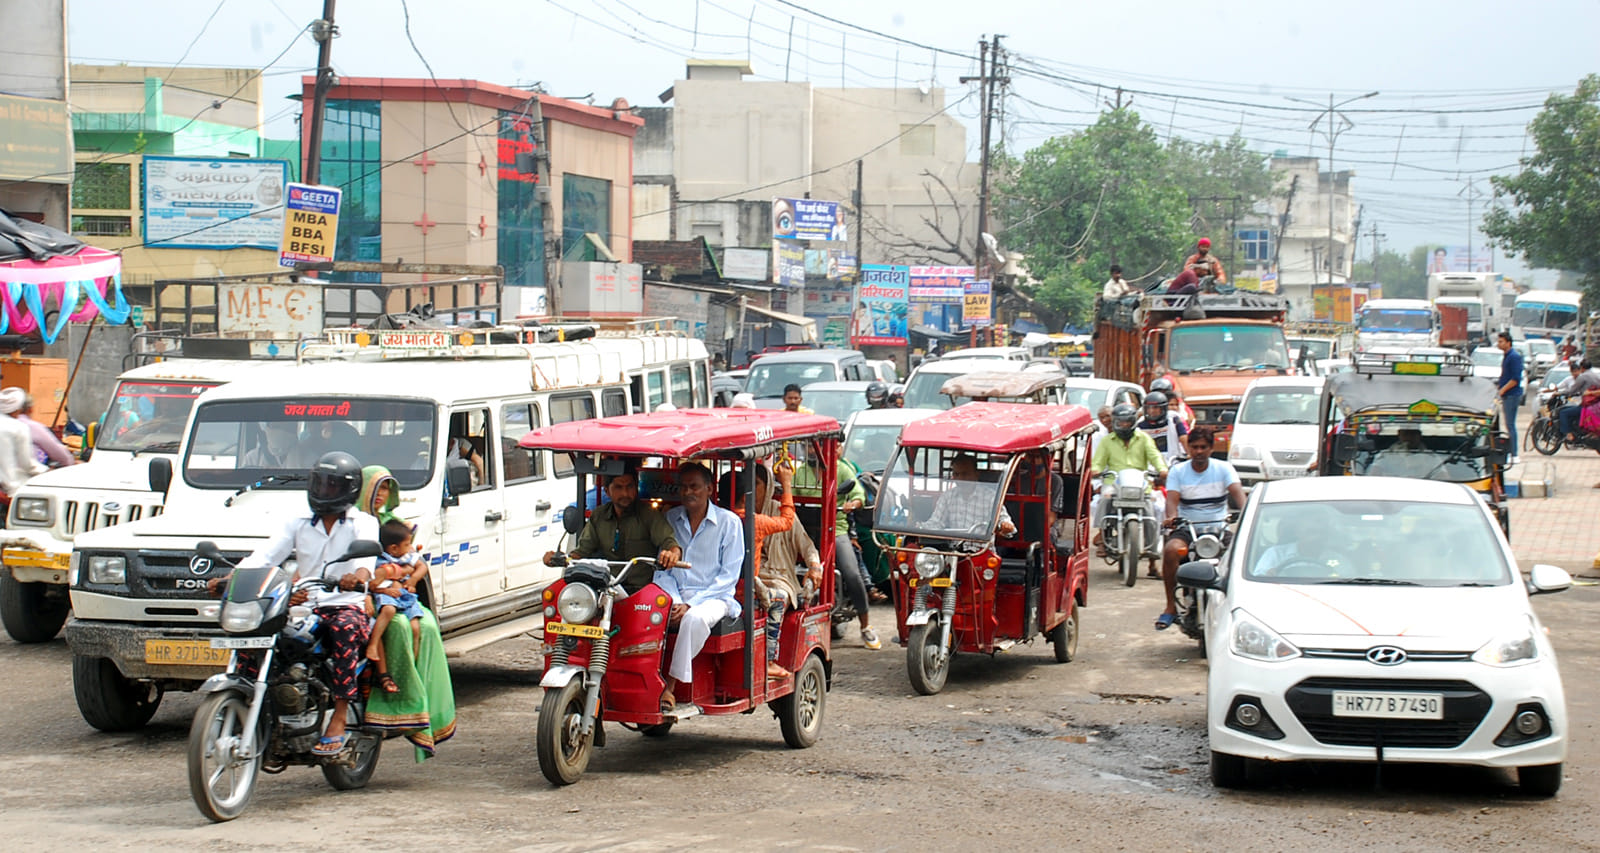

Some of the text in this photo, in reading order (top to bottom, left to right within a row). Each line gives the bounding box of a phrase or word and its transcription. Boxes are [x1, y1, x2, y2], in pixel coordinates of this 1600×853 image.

[301, 191, 336, 204] GEETA
[293, 212, 327, 226] MBA
[292, 227, 323, 240] BBA
[290, 241, 325, 255] BFSI
[861, 266, 906, 284] ाजवंश
[965, 296, 988, 305] LAW
[383, 333, 403, 346] जय
[405, 334, 431, 346] माता
[284, 400, 351, 416] जय माता दी
[175, 579, 209, 589] FOR
[155, 646, 172, 660] HR
[1346, 696, 1383, 712] HR77
[1399, 698, 1438, 713] 7490
